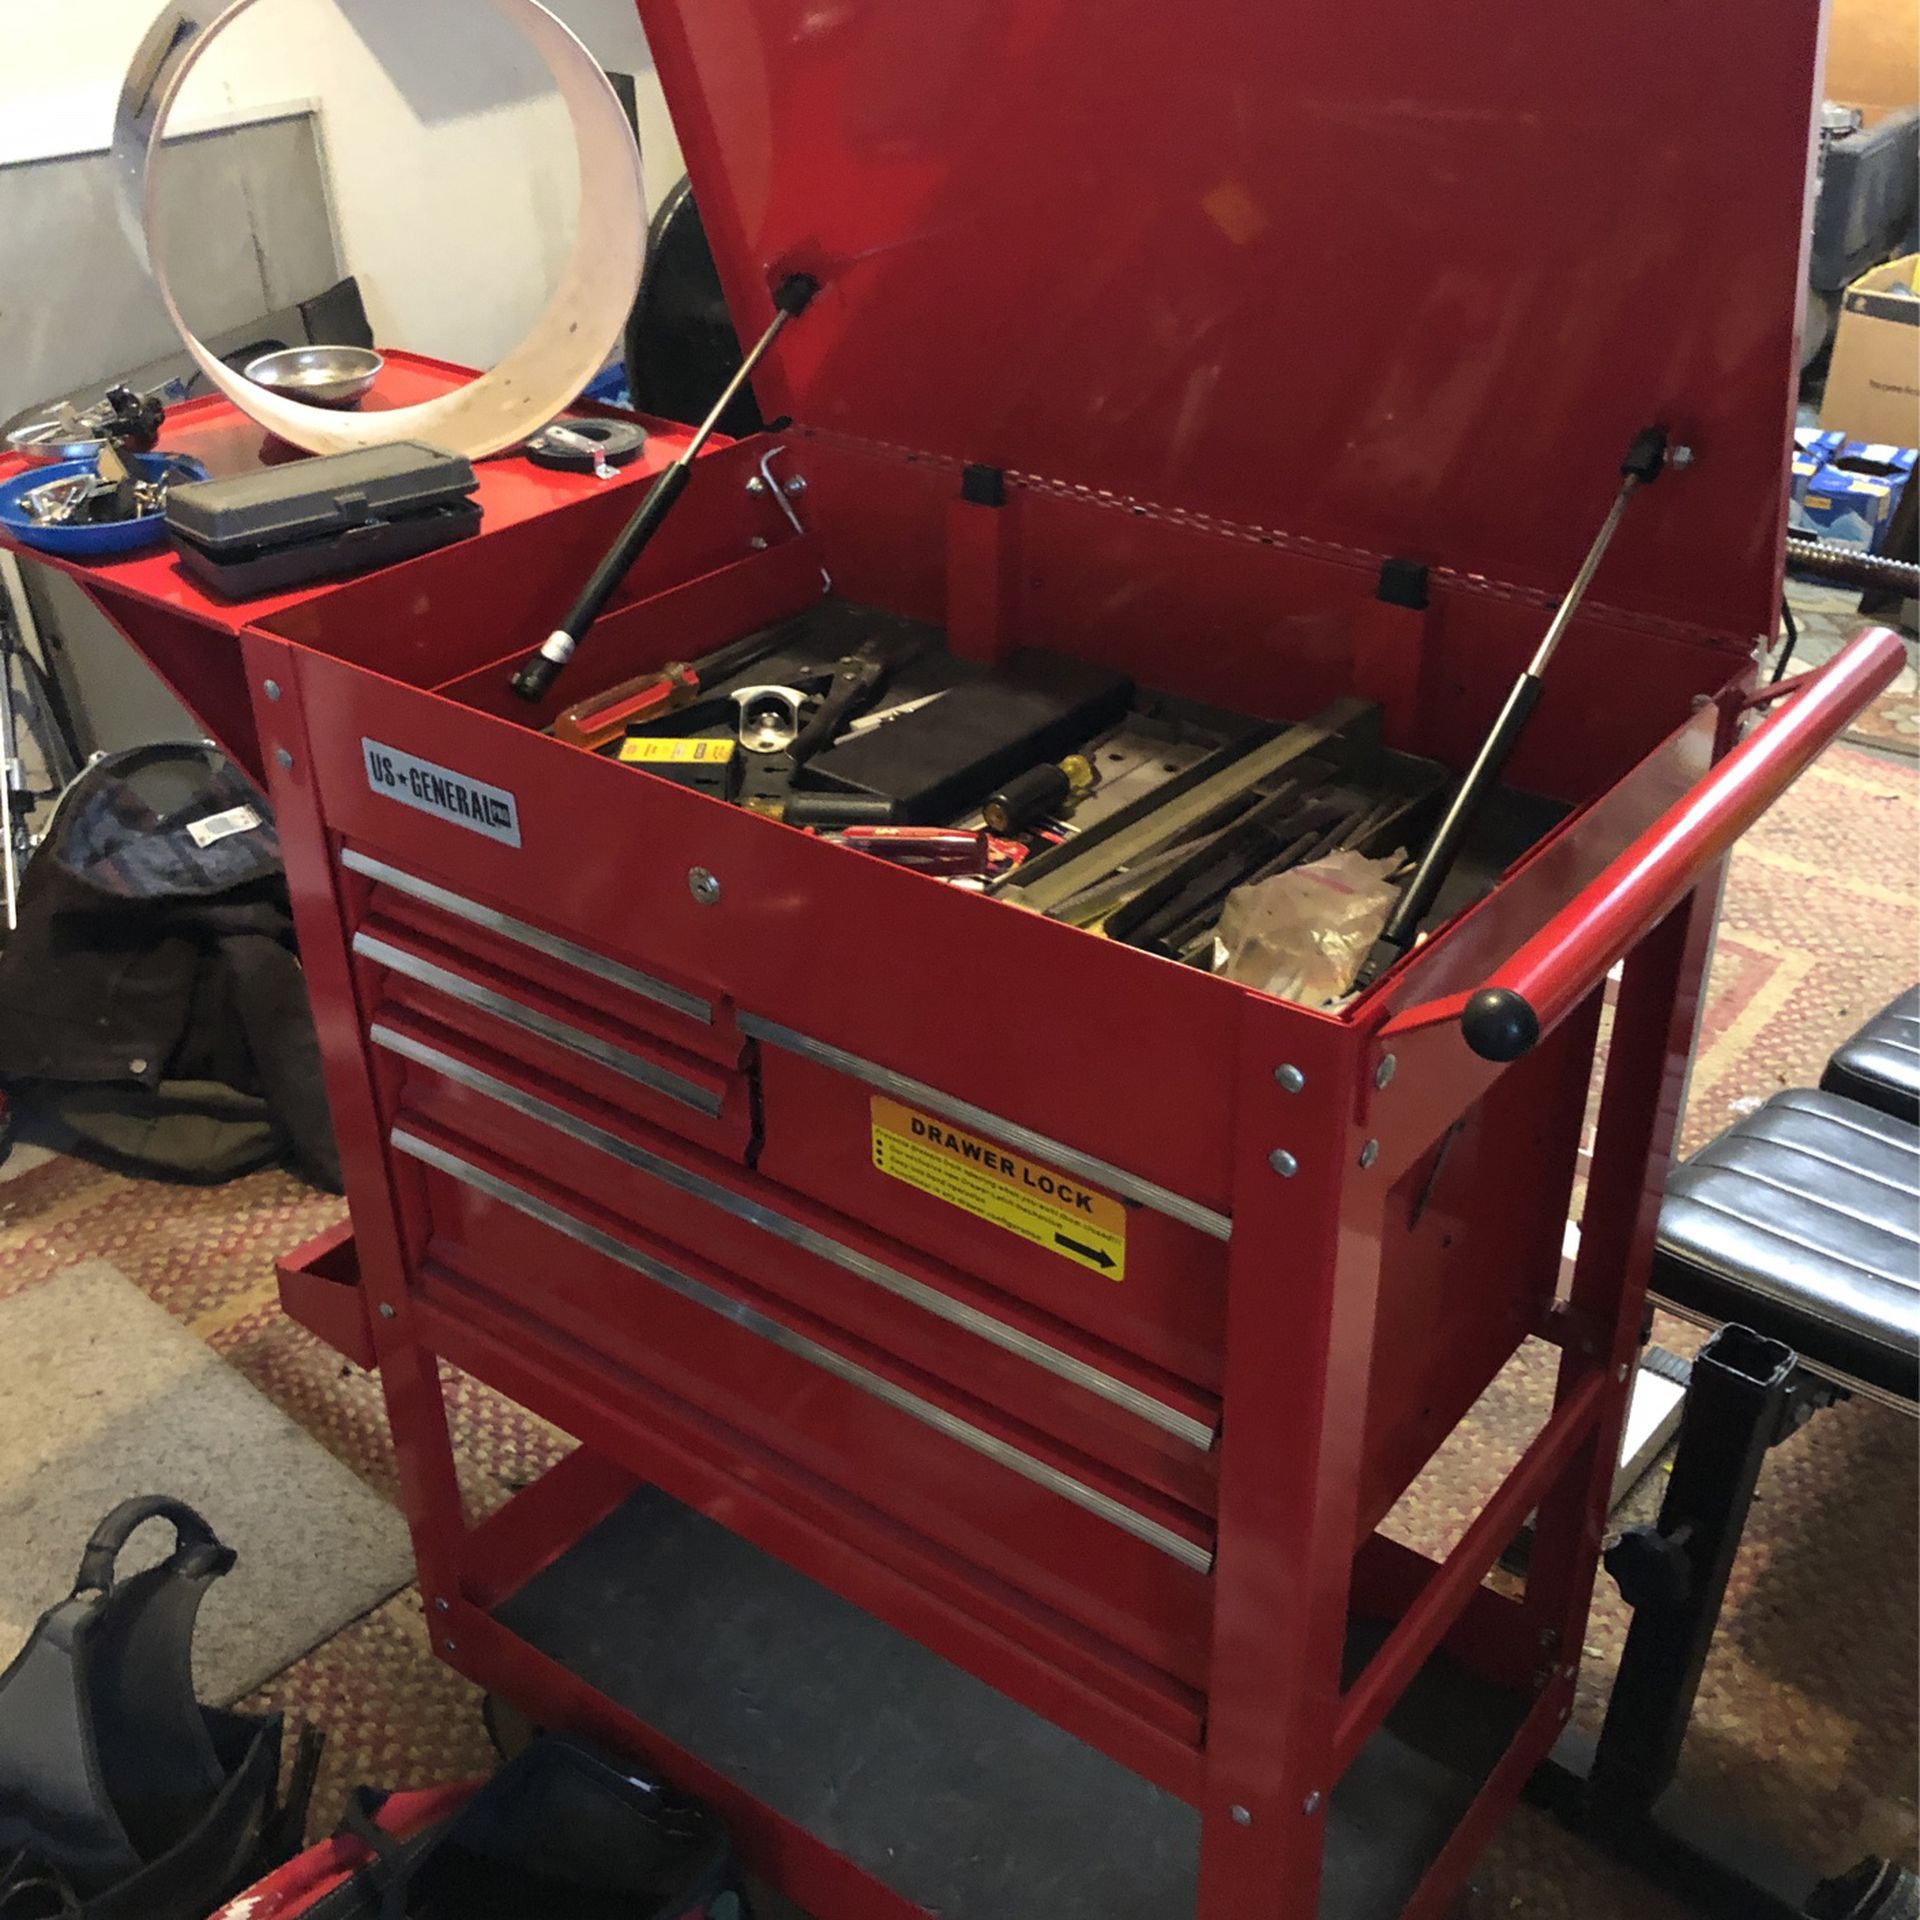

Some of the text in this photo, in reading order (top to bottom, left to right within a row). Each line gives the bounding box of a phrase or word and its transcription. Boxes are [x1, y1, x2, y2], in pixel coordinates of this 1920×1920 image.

[370, 751, 395, 787] US
[408, 767, 496, 827] GENERAL
[911, 1117, 1015, 1178] DRAWER
[1023, 1167, 1093, 1214] LOCK
